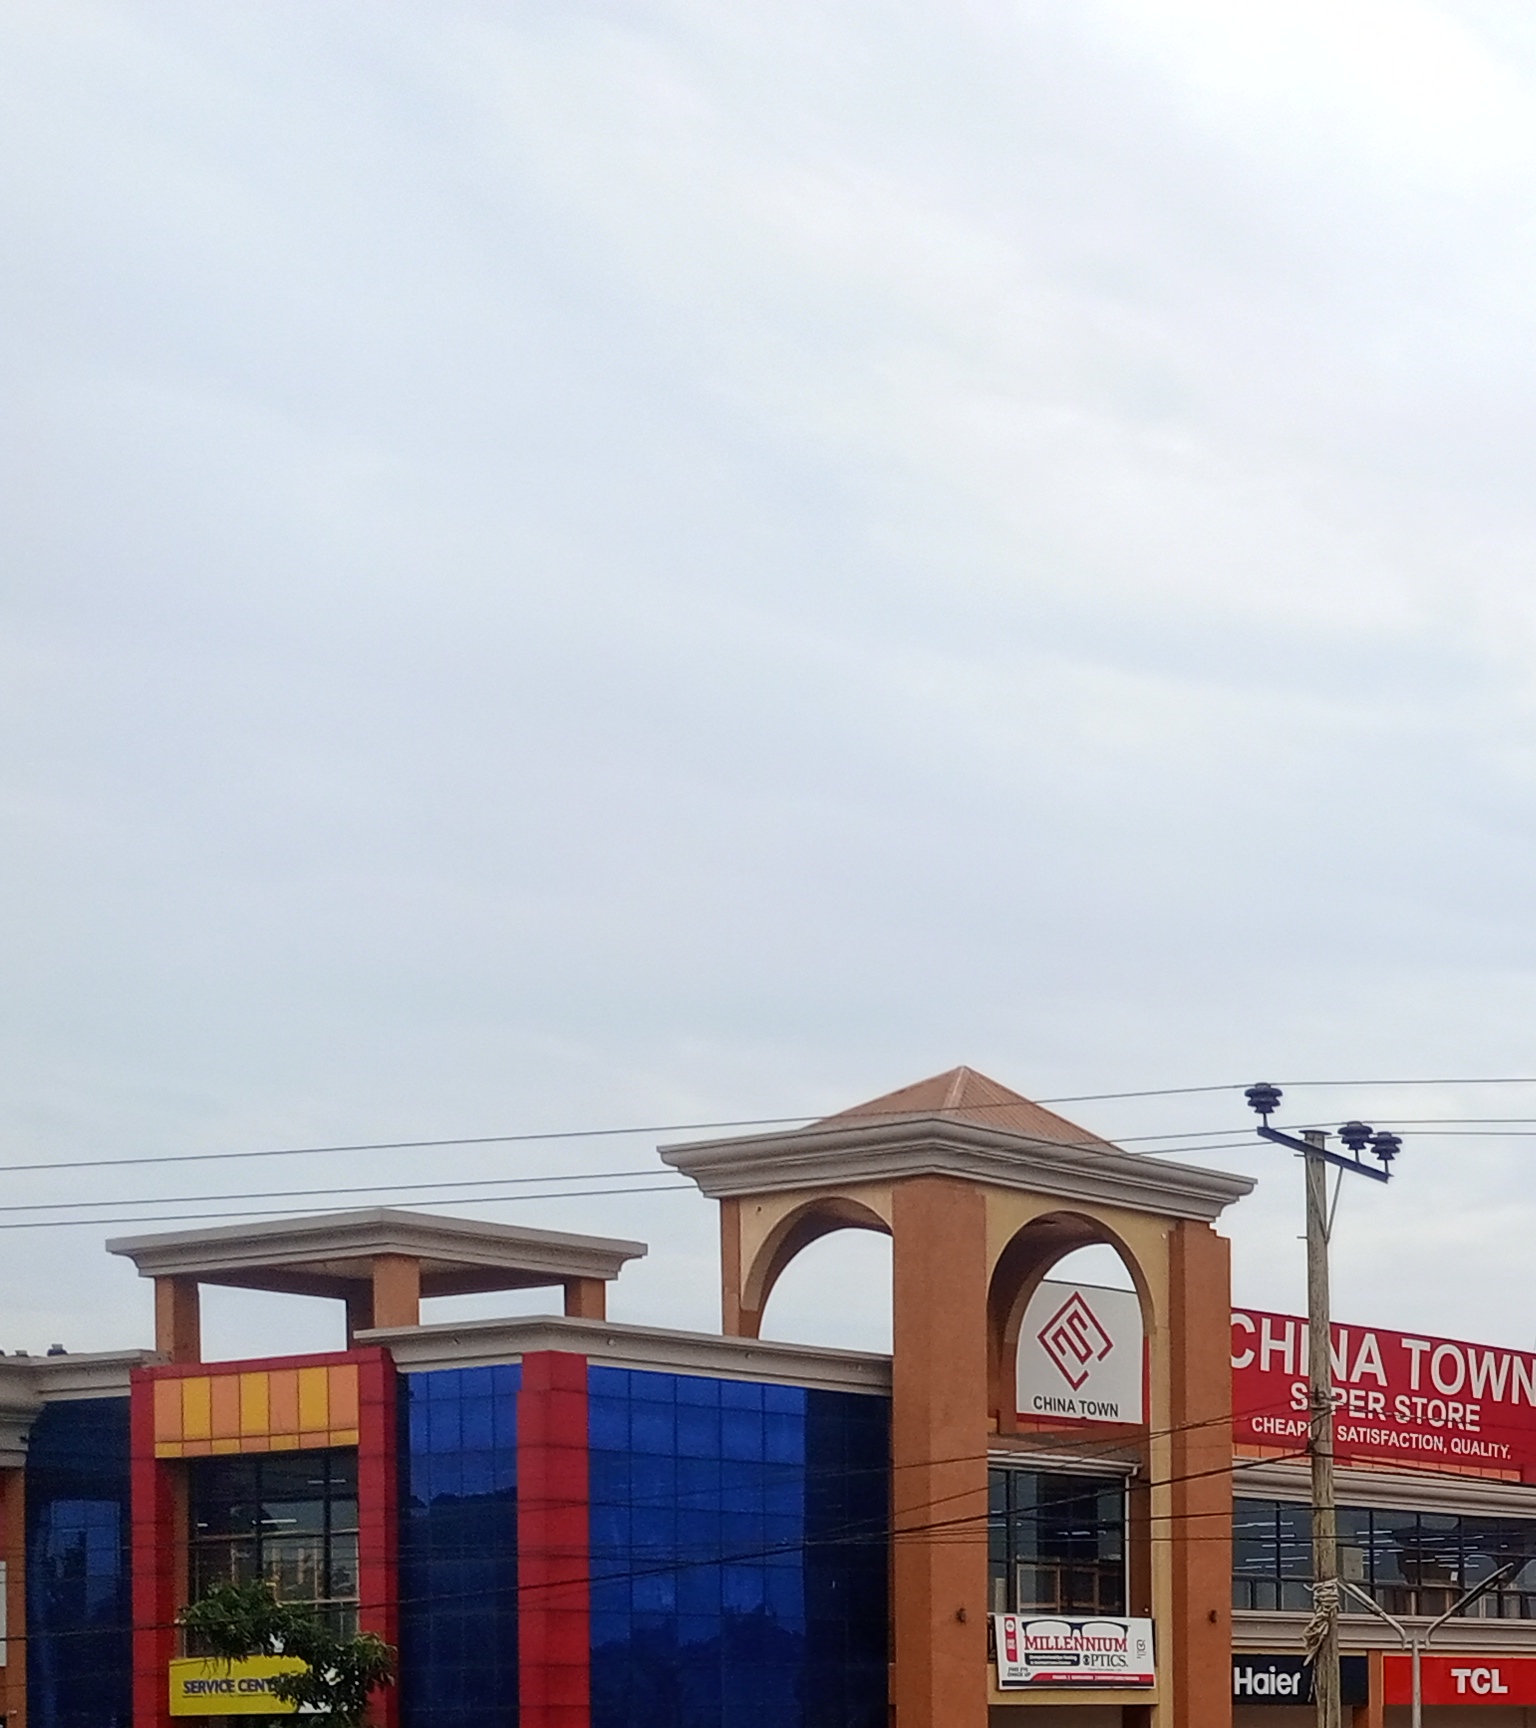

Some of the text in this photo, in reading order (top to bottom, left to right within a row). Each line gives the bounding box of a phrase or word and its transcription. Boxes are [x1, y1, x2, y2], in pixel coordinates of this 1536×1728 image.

[1231, 1313, 1388, 1387] CHINA
[1032, 1395, 1119, 1417] CHINA TOWN
[1290, 1382, 1481, 1432] SPER STORE
[1336, 1425, 1447, 1454] SATISFACTION,
[1451, 1437, 1512, 1460] QUALITY.
[1024, 1635, 1128, 1652] MILLENNIUM
[183, 1678, 275, 1695] SERVICE CENT
[1233, 1666, 1301, 1695] Haier
[1451, 1668, 1508, 1694] TCL
